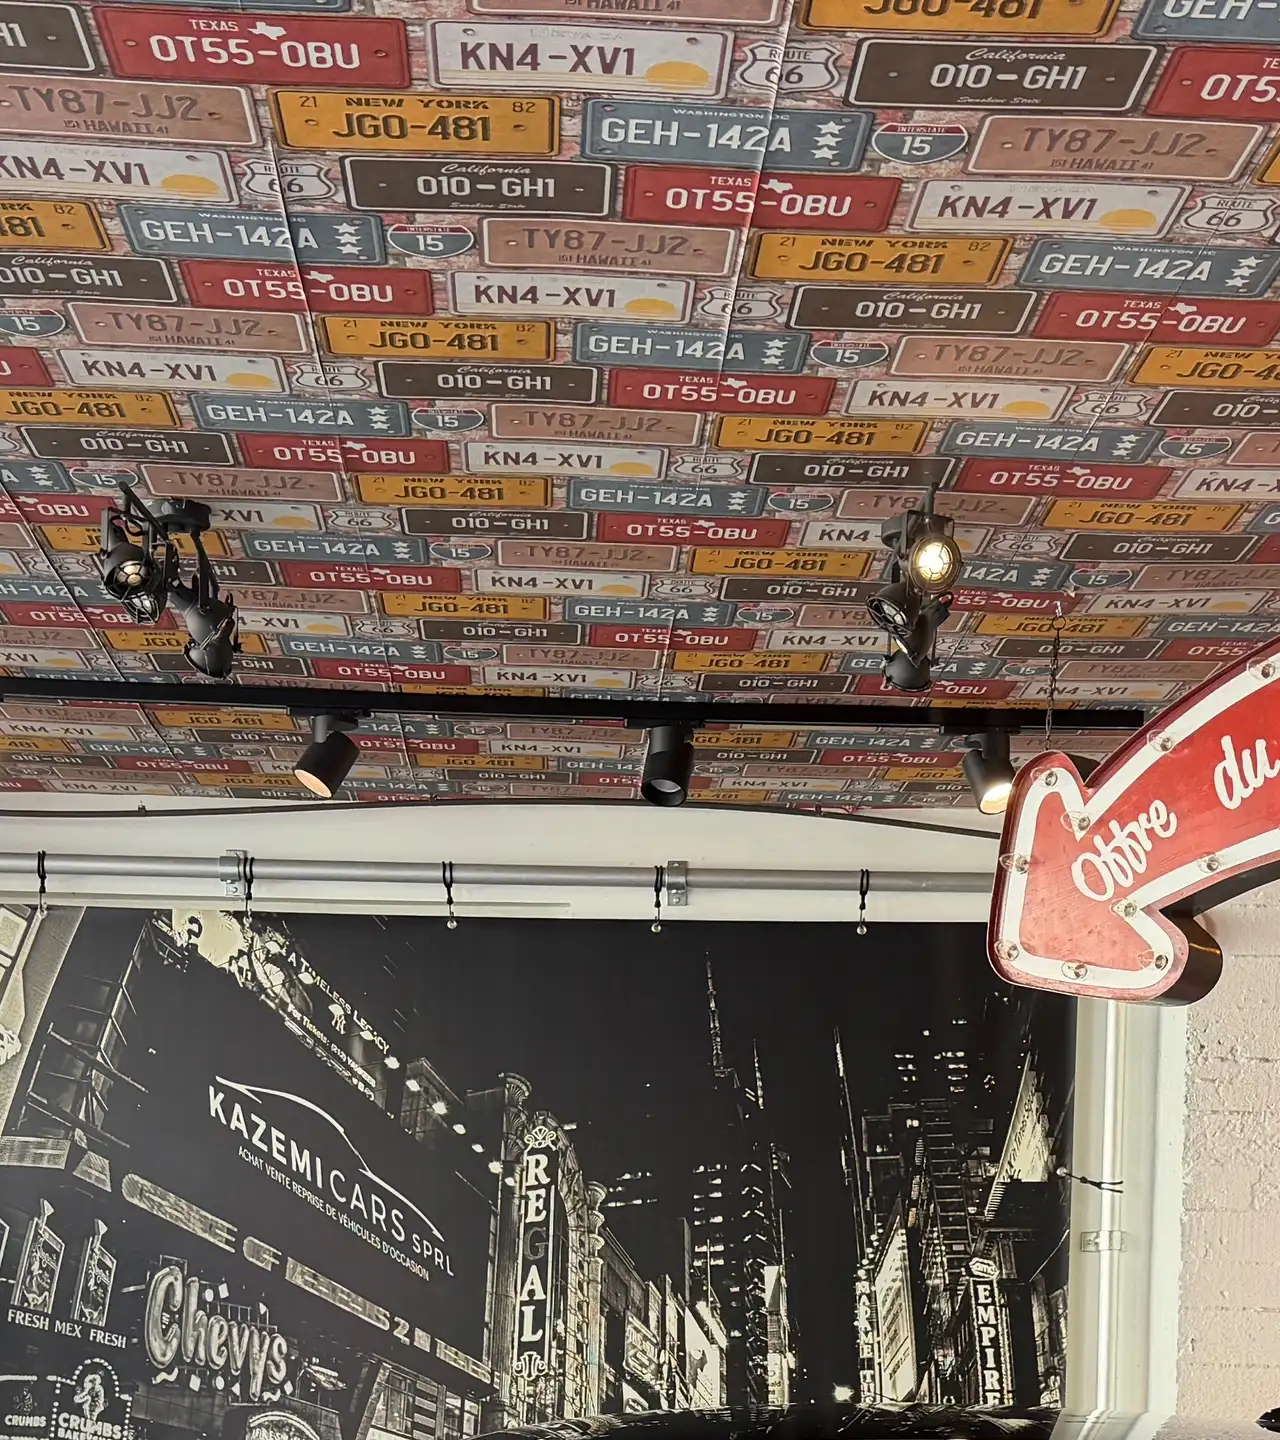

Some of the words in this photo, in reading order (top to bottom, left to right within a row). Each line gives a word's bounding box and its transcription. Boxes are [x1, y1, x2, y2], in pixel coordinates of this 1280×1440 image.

[188, 18, 239, 33] TEXAS
[964, 46, 1070, 62] California
[299, 96, 319, 108] 21
[345, 96, 406, 109] NEW
[416, 98, 490, 111] YORK
[512, 101, 537, 113] 82
[601, 118, 796, 153] GEH-142A
[899, 135, 934, 156] 15
[440, 162, 533, 175] California
[708, 175, 753, 187] TEXAS
[139, 220, 319, 249] GEH-142A
[1037, 253, 1219, 281] GEH-142A
[954, 431, 1104, 452] GEH-142A
[580, 488, 715, 507] GEH-142A
[1070, 799, 1179, 903] Offre
[1213, 734, 1280, 811] du
[287, 951, 297, 967] A
[237, 1144, 264, 1171] ACHAT
[264, 1160, 291, 1190] VENTE
[292, 1179, 325, 1212] REPRISE
[325, 1202, 336, 1220] DE
[337, 1209, 381, 1251] VÉHICULES
[382, 1242, 431, 1282] D'OCCASION
[411, 1232, 455, 1277] SPRL
[519, 1153, 552, 1344] REGAL
[7, 1309, 50, 1332] FRESH
[54, 1320, 83, 1339] MEX
[89, 1329, 127, 1349] FRESH
[144, 1264, 289, 1402] Chevys
[4, 1413, 48, 1429] CRUMBS
[57, 1411, 122, 1440] CRUMBS
